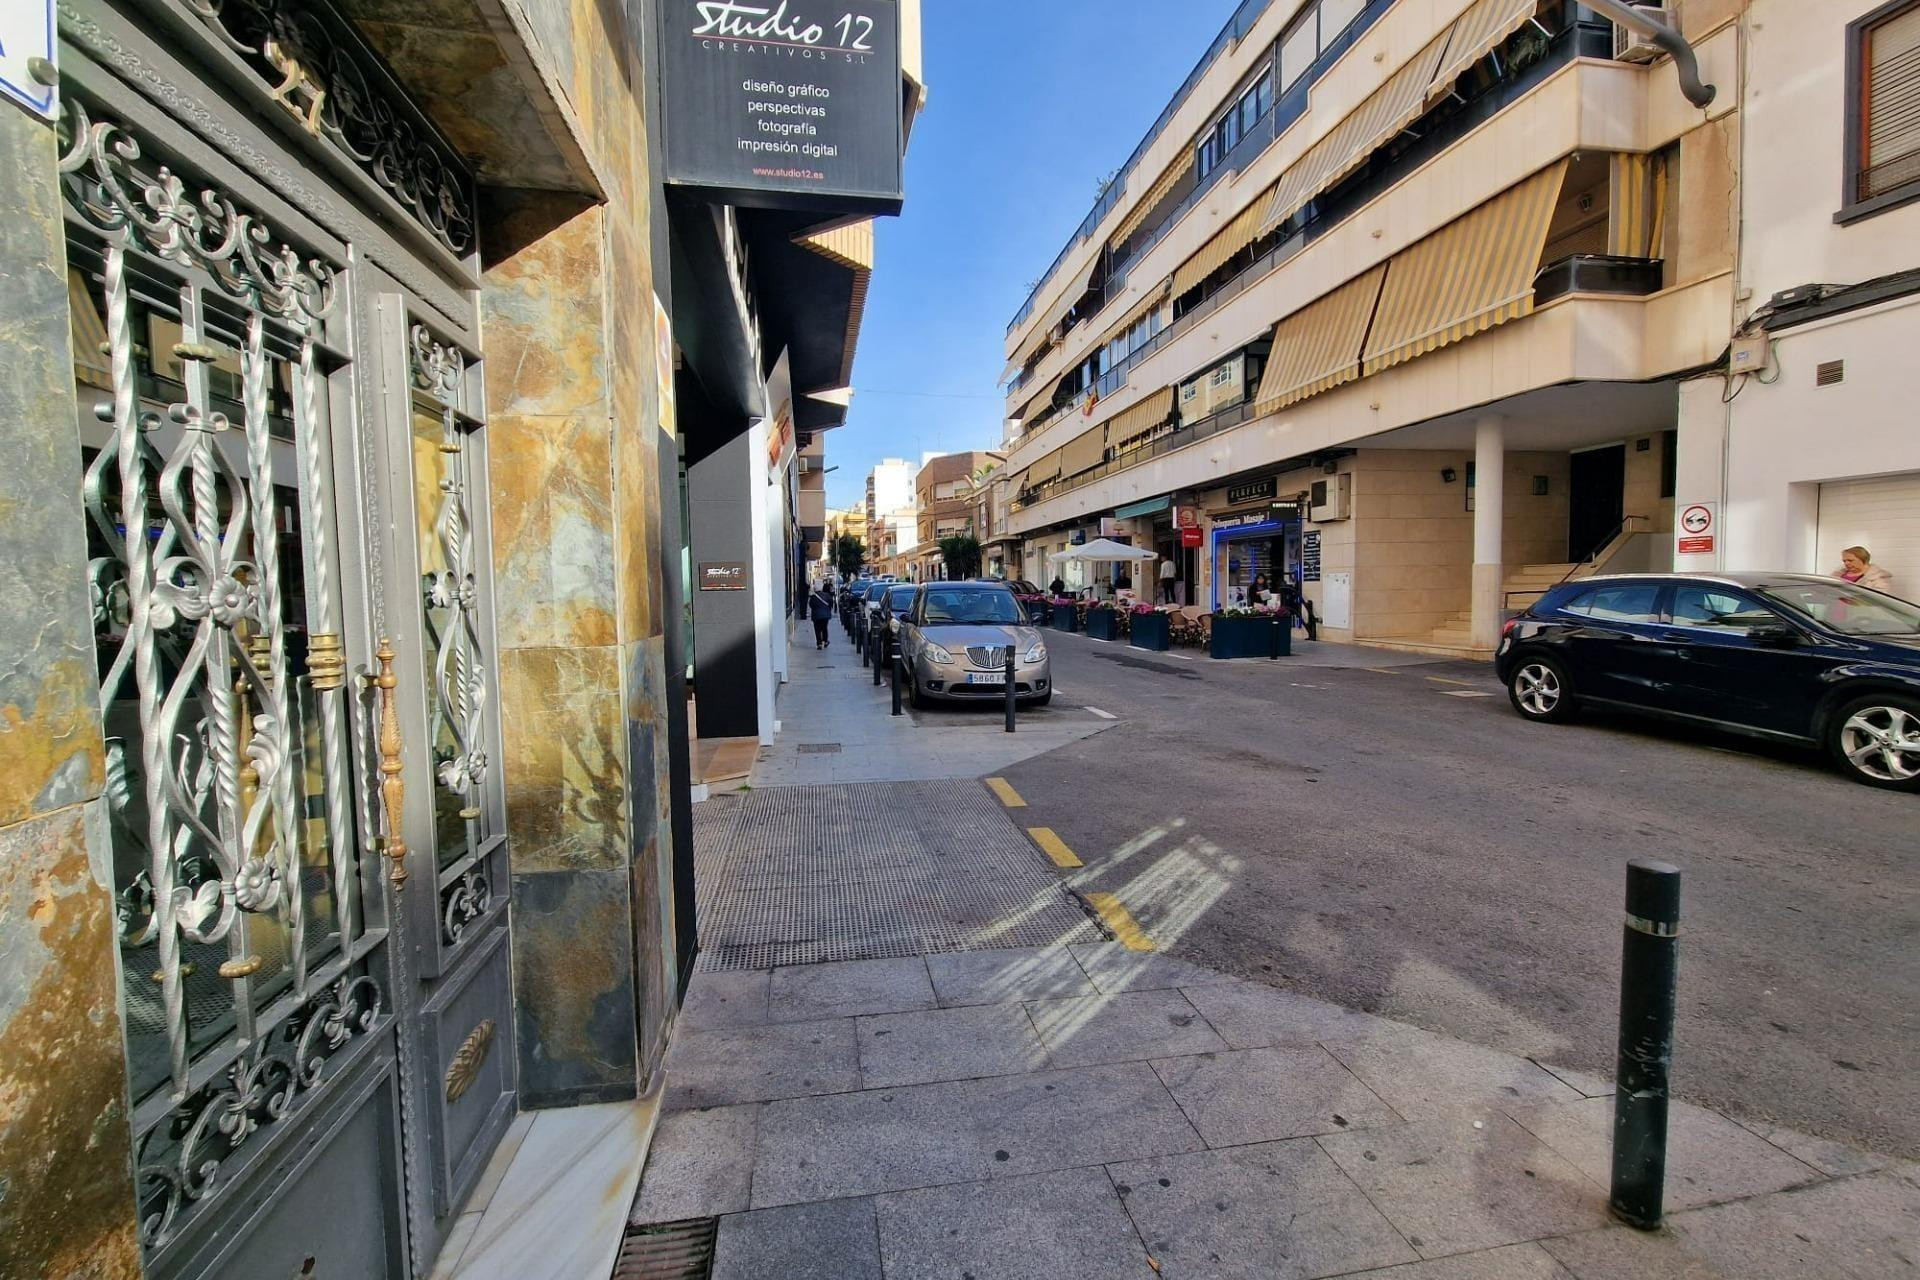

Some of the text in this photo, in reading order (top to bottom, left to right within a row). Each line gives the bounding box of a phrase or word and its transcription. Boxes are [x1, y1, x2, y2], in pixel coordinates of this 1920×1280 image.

[692, 0, 874, 50] Studio 12
[702, 40, 826, 60] CREATIVOS
[742, 79, 830, 98] diseño gráfico
[747, 101, 826, 117] perspectivas
[737, 137, 838, 158] impresión digital
[752, 166, 824, 180] www.studio12.es
[1231, 483, 1269, 499] PERFECT
